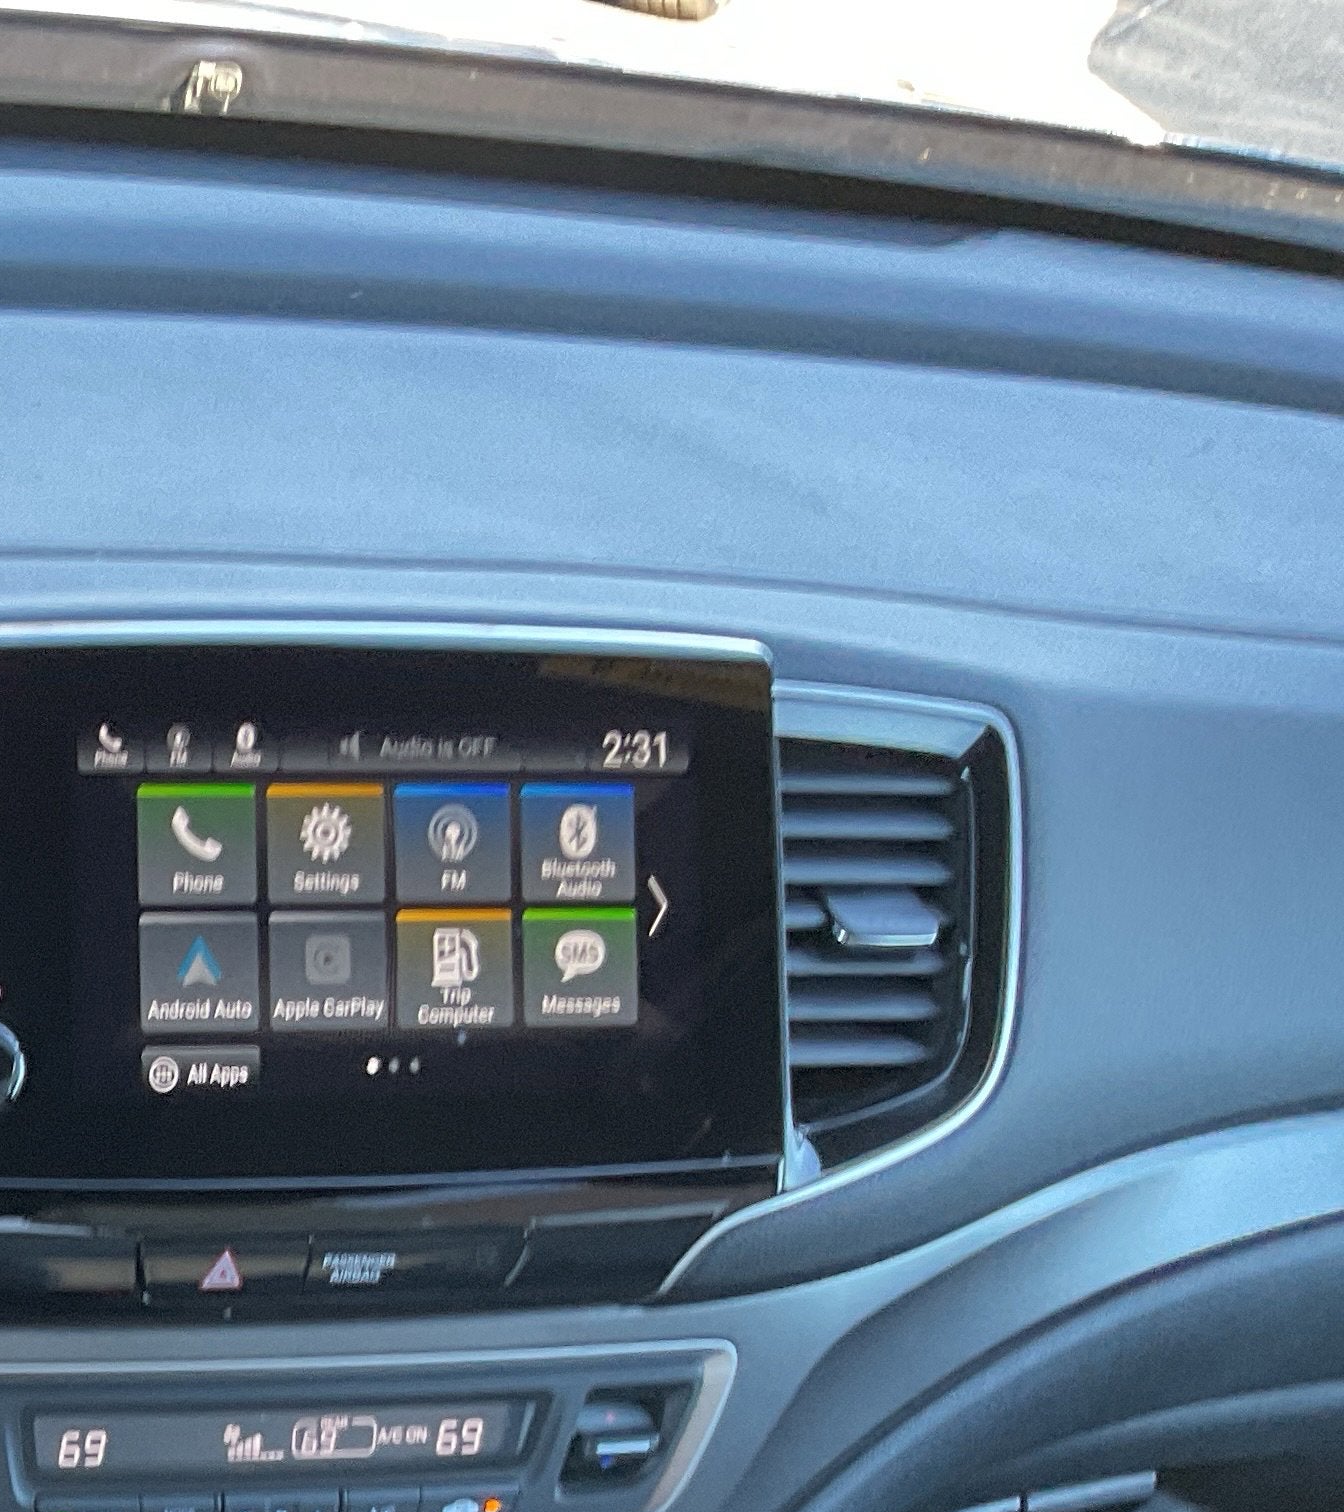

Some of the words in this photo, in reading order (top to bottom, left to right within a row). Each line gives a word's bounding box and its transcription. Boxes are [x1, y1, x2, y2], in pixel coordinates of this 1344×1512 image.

[380, 736, 433, 758] Audio
[458, 735, 496, 757] OFF
[602, 729, 668, 769] 2:31
[441, 869, 467, 891] FM
[541, 856, 616, 880] Bluetooth
[173, 871, 224, 895] Phone
[294, 870, 359, 896] Settings
[556, 879, 603, 899] Audio
[561, 940, 600, 964] SMS
[439, 986, 472, 1005] Trip
[541, 993, 621, 1018] Messages
[148, 998, 211, 1021] Android
[214, 998, 252, 1020] Auto
[273, 997, 320, 1021] Apple
[323, 996, 385, 1021] CarPlay
[418, 1003, 495, 1028] Computer
[187, 1062, 208, 1085] All
[210, 1062, 249, 1087] Apps
[406, 1425, 428, 1445] ON
[436, 1418, 484, 1456] 69
[58, 1429, 107, 1469] 69
